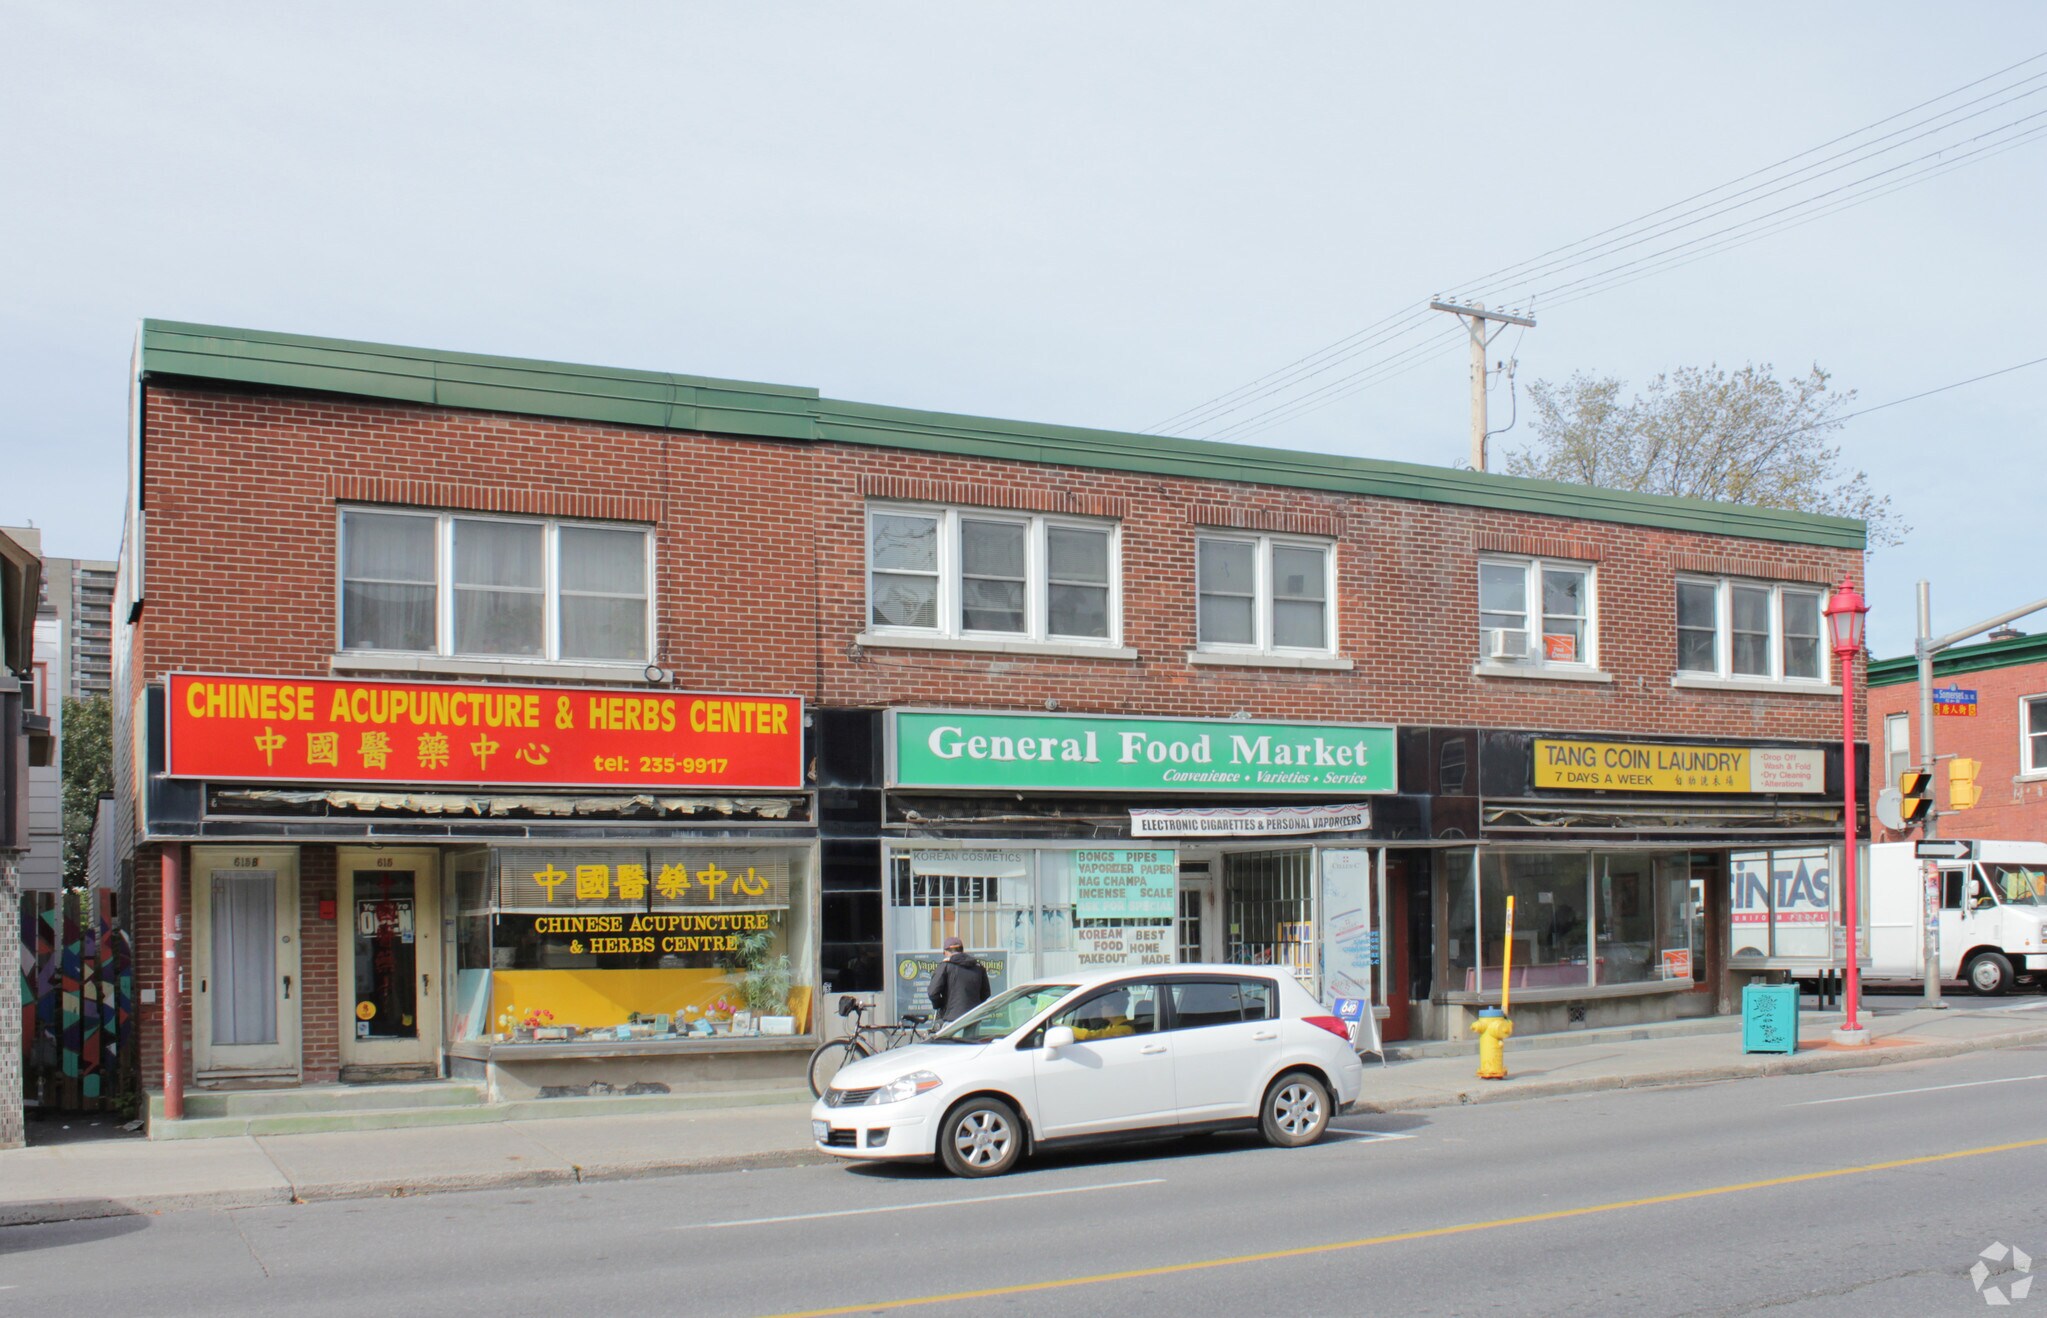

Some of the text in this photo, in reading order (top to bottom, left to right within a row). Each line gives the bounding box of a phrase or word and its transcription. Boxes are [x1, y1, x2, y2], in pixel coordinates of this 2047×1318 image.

[186, 681, 788, 735] CHINESE ACUPUNCTURE & HERBS CENTER
[254, 725, 551, 770] 中國醫藥中心
[928, 726, 1369, 766] General Food Market
[1545, 746, 1742, 772] TANG COIN LAUNDRY
[1763, 753, 1781, 761] Drop
[593, 754, 728, 774] tel: 235-9917
[1162, 768, 1367, 784] Convenience Varieties Service
[1555, 772, 1654, 785] 7 DAYS A WEEK
[1763, 771, 1811, 780] Dry Cleaning
[1141, 818, 1199, 831] ELECTRONIC
[1200, 818, 1256, 831] CIGARETTES
[1257, 819, 1265, 830] &
[1266, 817, 1311, 830] PERSONAL
[377, 858, 393, 867] 615
[913, 852, 1022, 862] KOREAN COSMETICS
[1078, 851, 1157, 862] BONGS PIPES
[1078, 863, 1173, 874] VAPORIZER PAPER
[532, 863, 769, 902] 中國醫藥中心
[1078, 876, 1147, 886] NAG CHAMPA
[1079, 888, 1173, 898] INCENSE SCALE
[535, 914, 769, 933] CHINESE ACUPUNCTURE
[1078, 928, 1123, 940] KOREAN
[1136, 930, 1165, 940] BEST
[570, 936, 738, 954] & HERBS CENTRE
[1094, 941, 1124, 951] FOOD
[1130, 943, 1159, 953] HOME
[1078, 954, 1127, 964] TAKEOUT
[1141, 954, 1171, 964] MADE
[918, 960, 938, 972] Vapi
[977, 960, 1003, 972] aping
